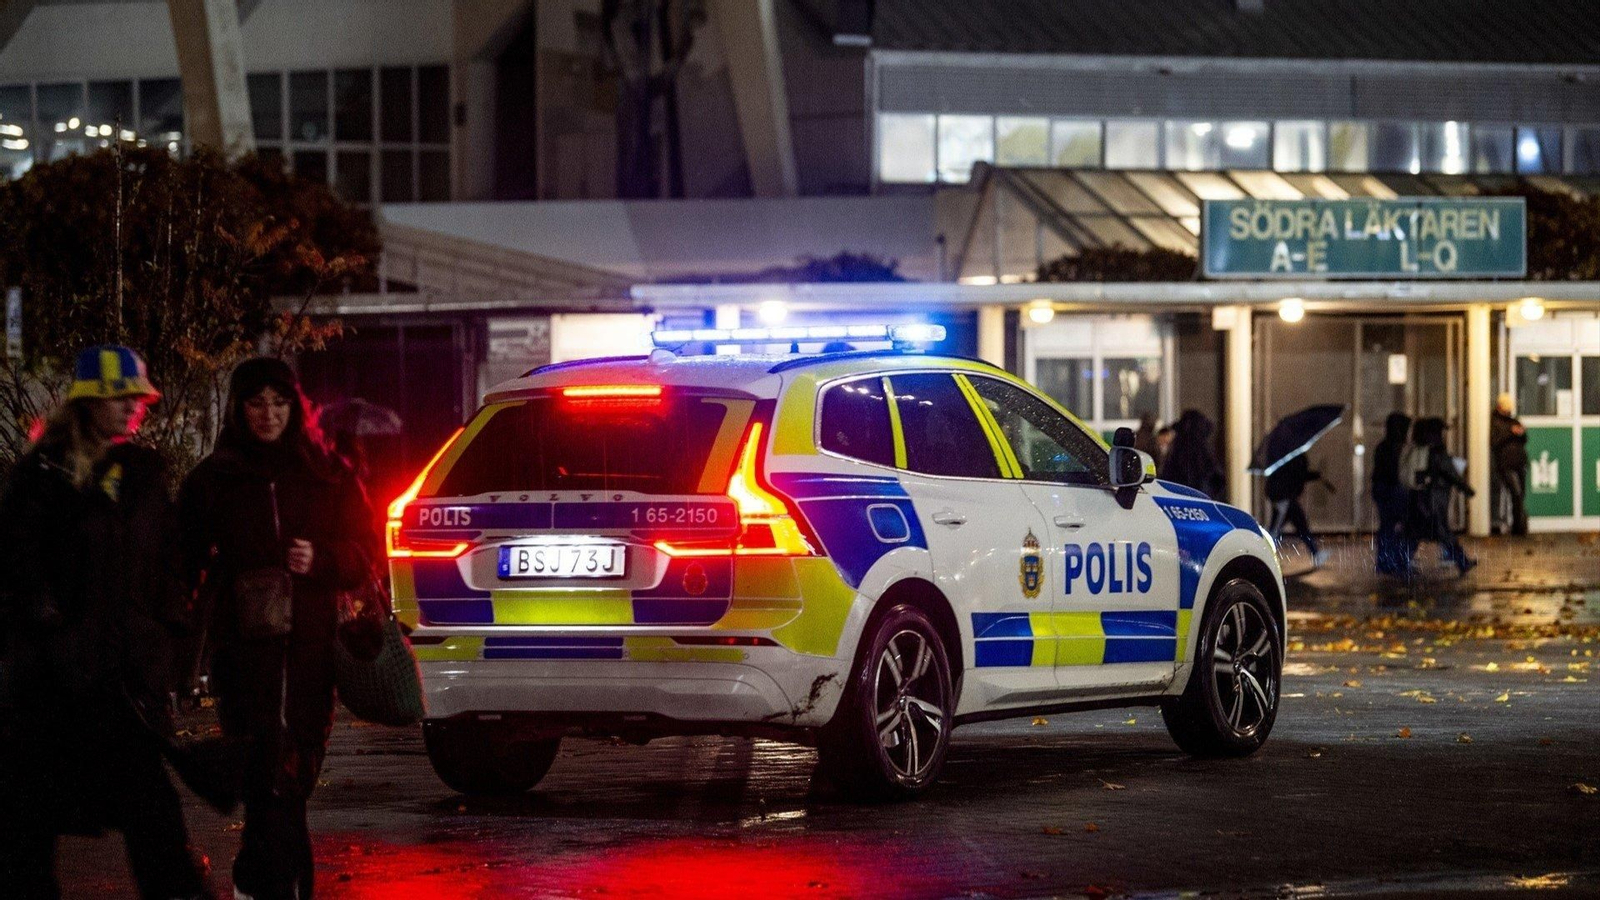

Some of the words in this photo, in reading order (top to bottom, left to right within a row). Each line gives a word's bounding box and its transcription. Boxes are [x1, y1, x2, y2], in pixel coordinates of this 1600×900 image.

[1229, 200, 1339, 240] SÖDRA
[1345, 200, 1500, 240] LÄKTAREN
[1270, 240, 1328, 272] A-E
[489, 493, 623, 502] VOLVO
[419, 508, 472, 526] POLIS
[631, 508, 639, 523] 1
[646, 507, 718, 523] 65-2150
[518, 549, 561, 573] BSJ
[570, 548, 616, 573] 73J
[1064, 541, 1153, 595] POLIS
